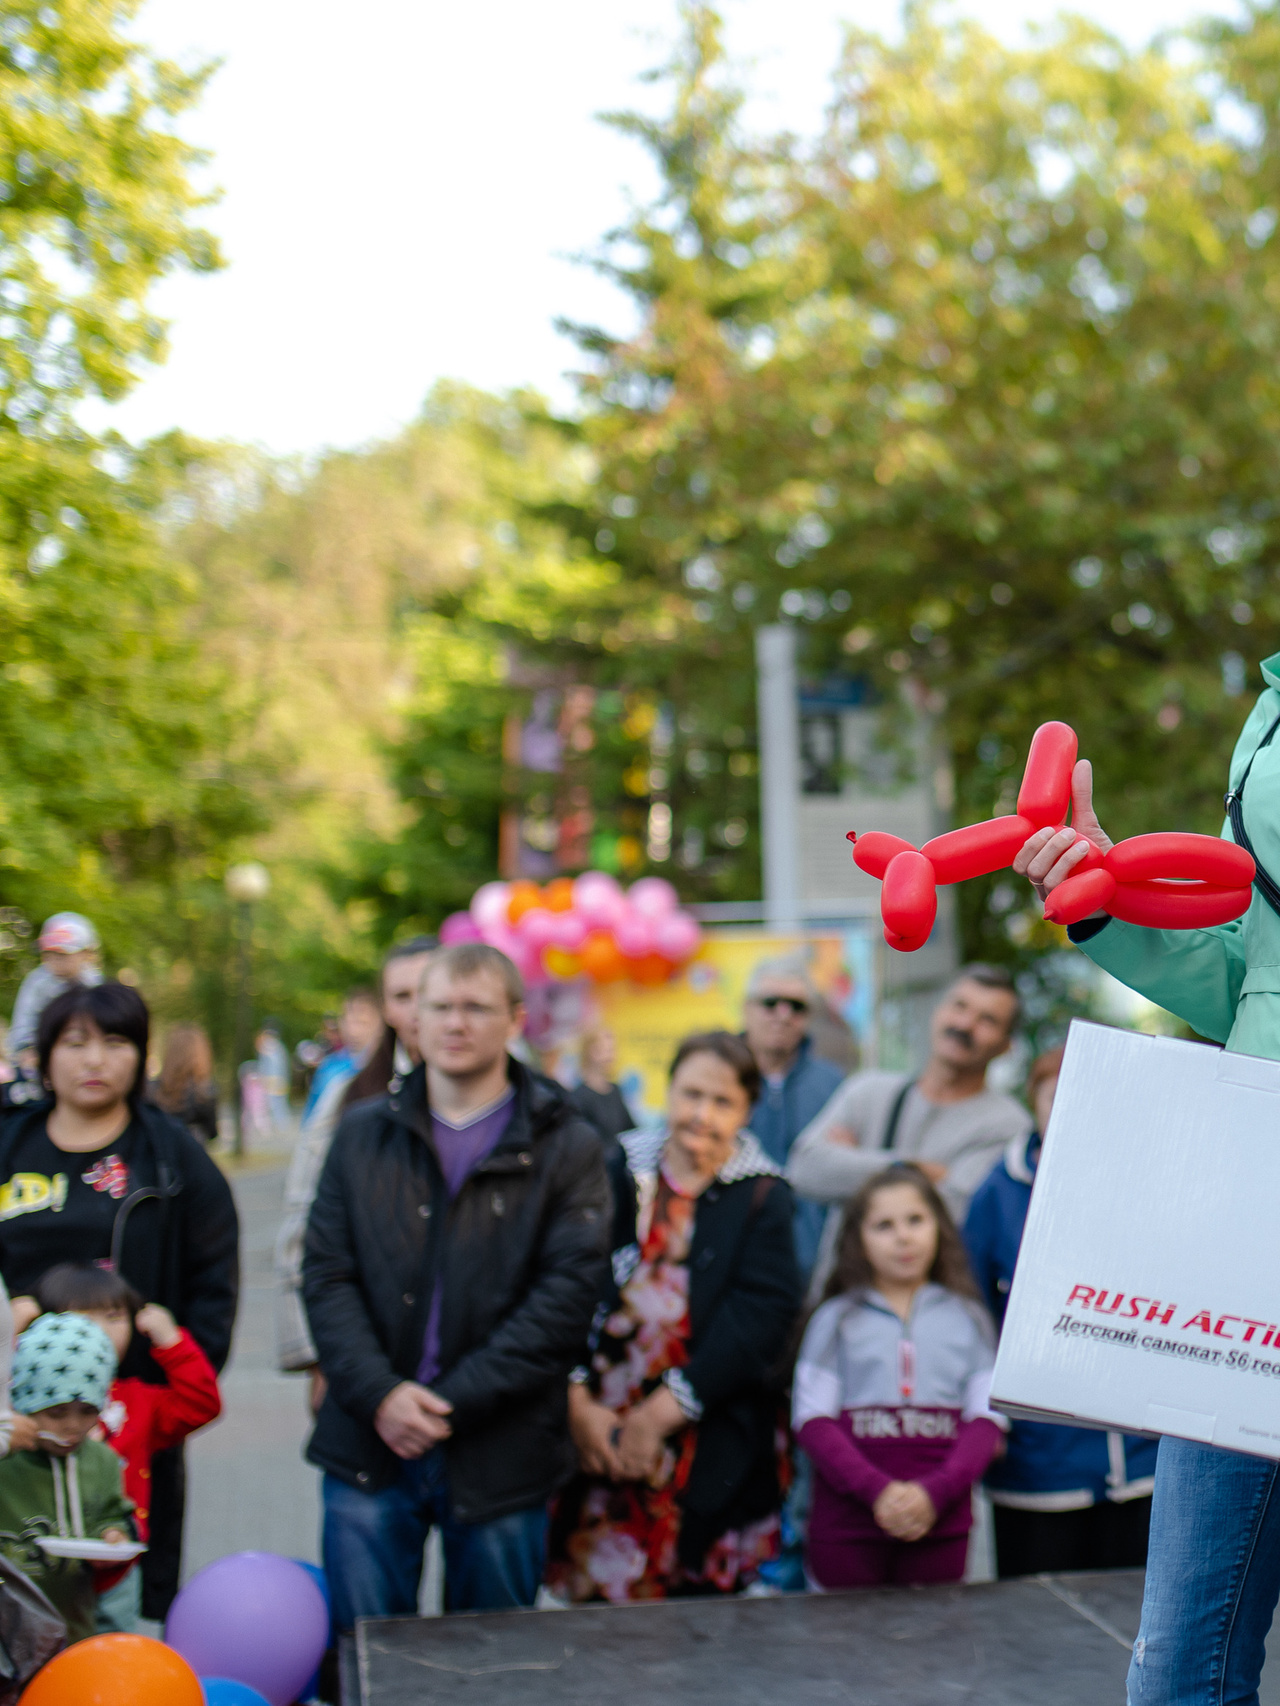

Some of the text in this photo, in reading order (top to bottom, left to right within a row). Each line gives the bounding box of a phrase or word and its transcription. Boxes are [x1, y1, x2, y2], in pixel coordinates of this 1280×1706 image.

[1065, 1283, 1178, 1326] RUSH
[1053, 1314, 1138, 1345] Детский
[1140, 1334, 1222, 1363] самокат
[1224, 1349, 1248, 1370] S6
